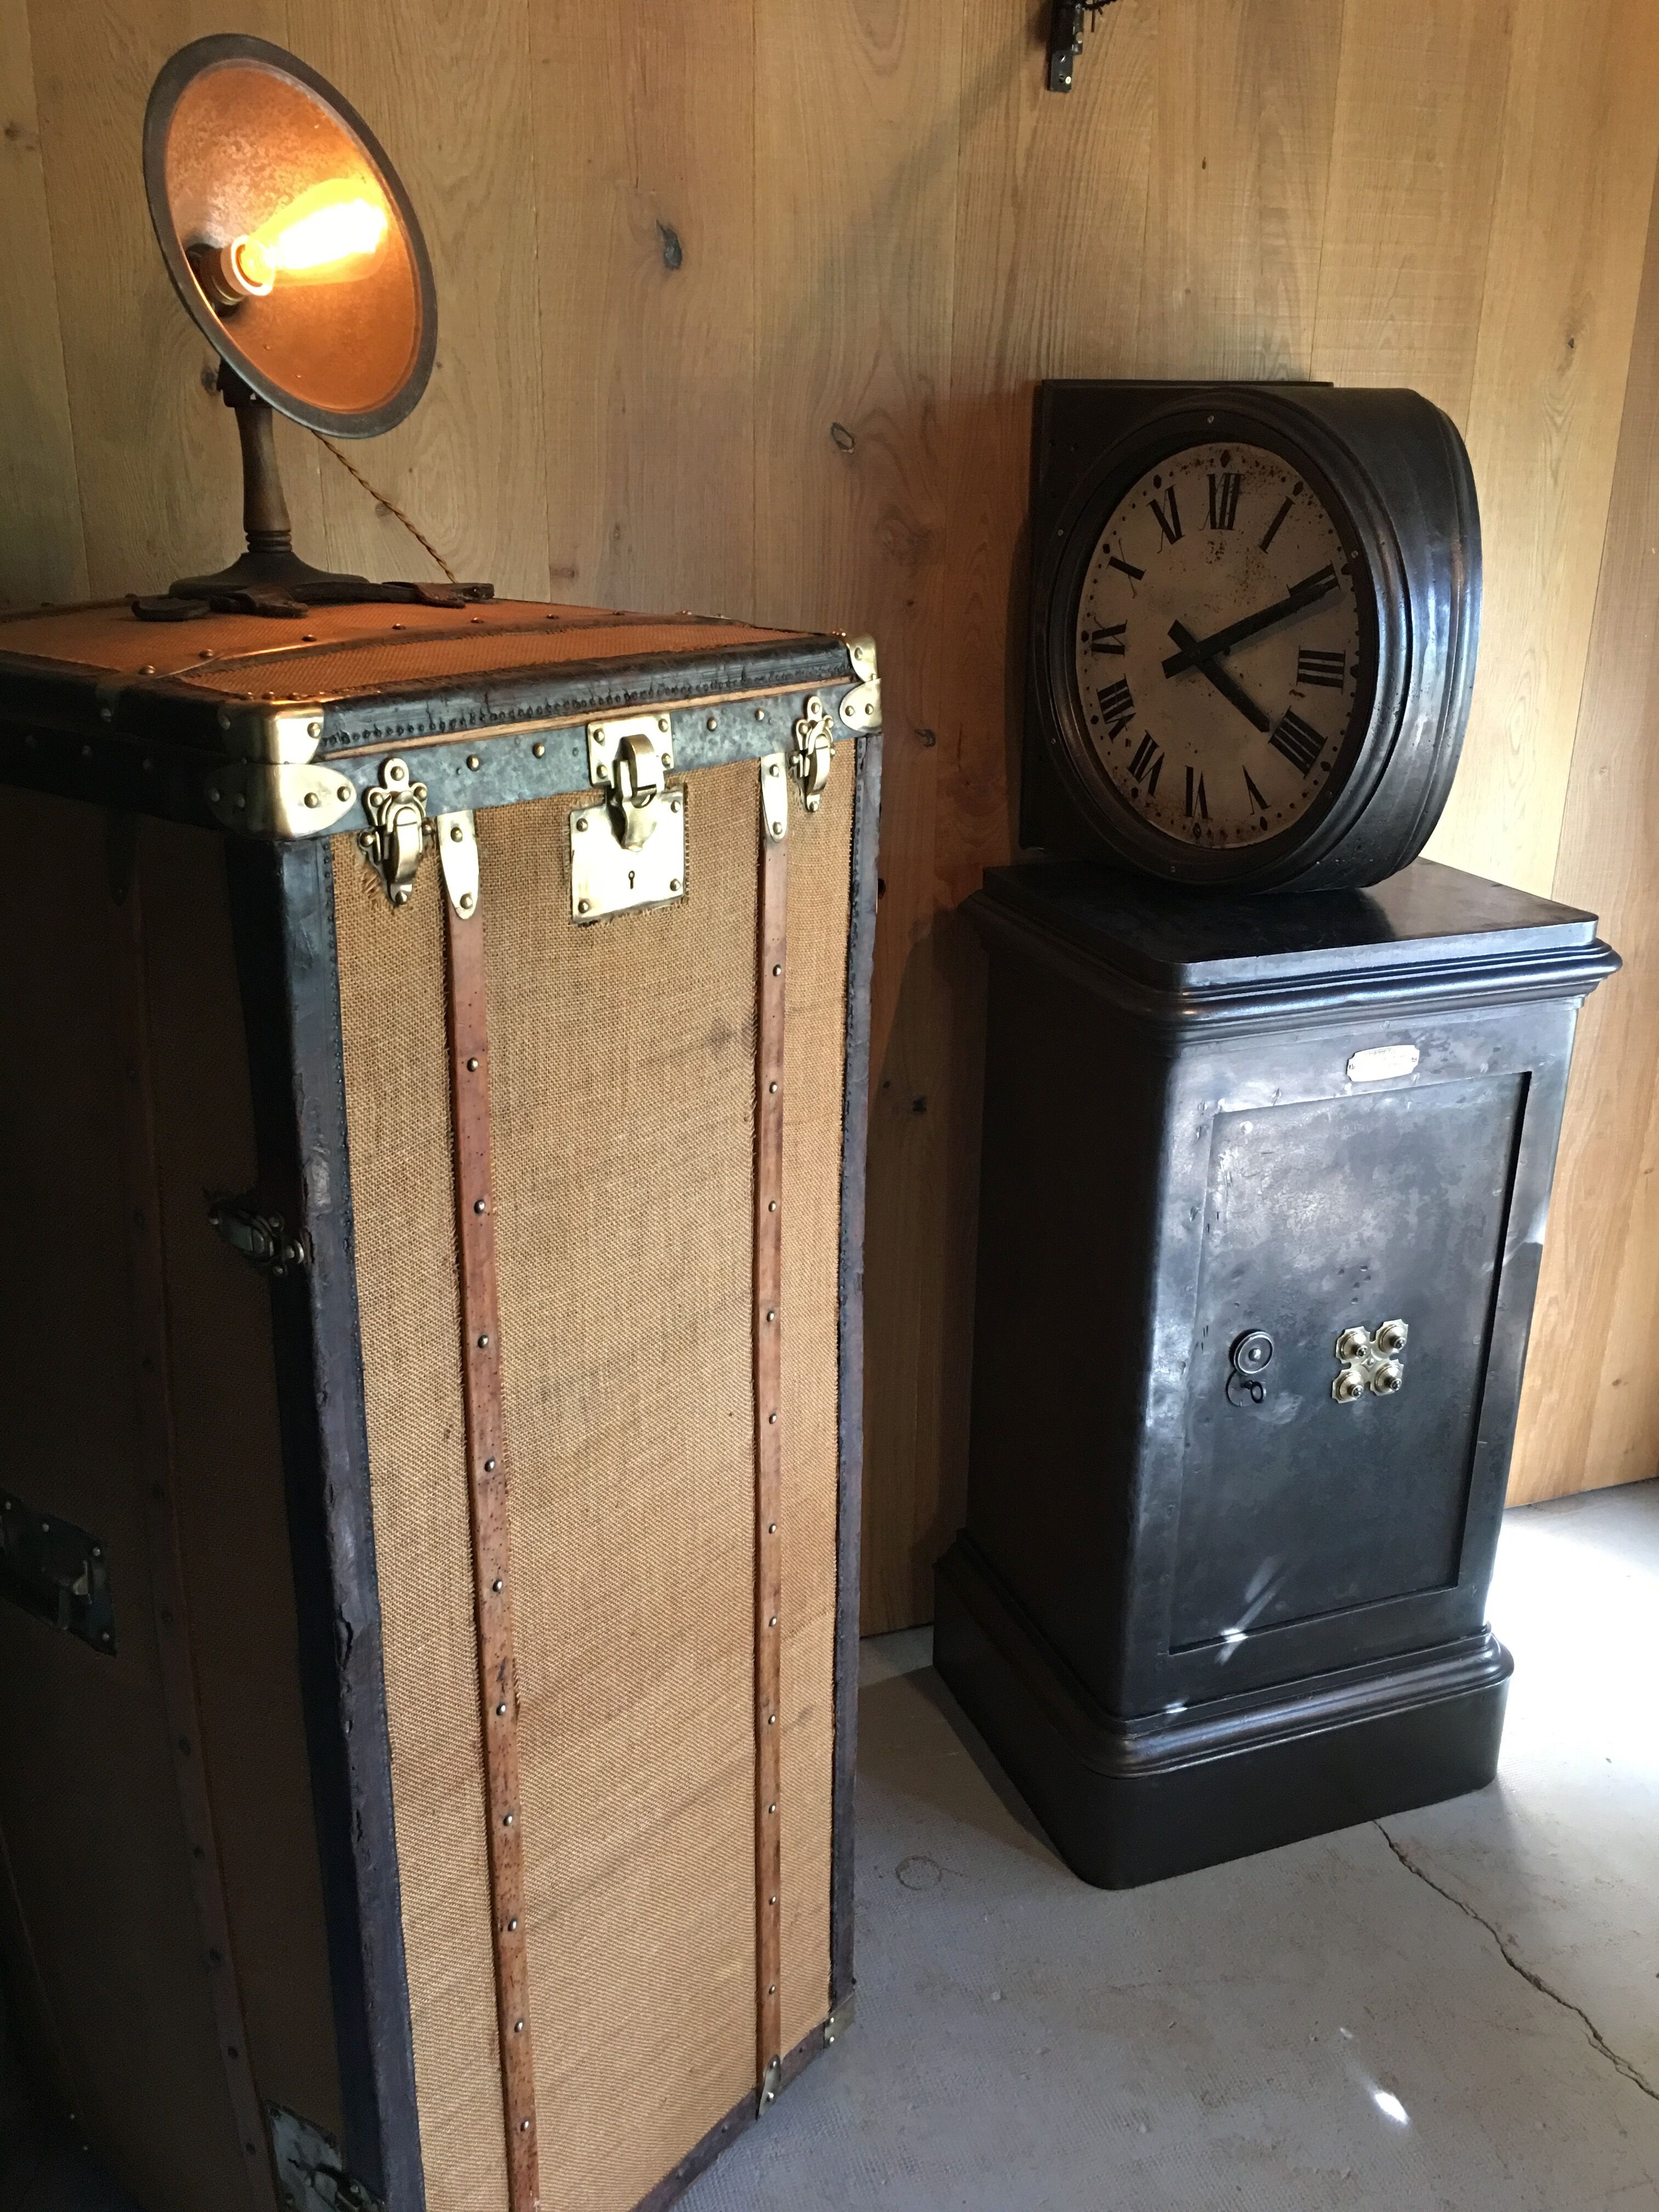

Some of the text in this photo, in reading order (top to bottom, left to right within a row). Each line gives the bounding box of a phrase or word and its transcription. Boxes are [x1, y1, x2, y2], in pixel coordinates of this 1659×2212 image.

[1147, 484, 1186, 554] XI
[1199, 473, 1244, 531] XII
[1259, 495, 1295, 554] I
[1296, 645, 1346, 695] III
[1096, 674, 1136, 743] VIII
[1127, 729, 1165, 799] VII
[1268, 705, 1329, 780] IIII
[1184, 765, 1211, 820] VI
[1242, 765, 1271, 815] V
